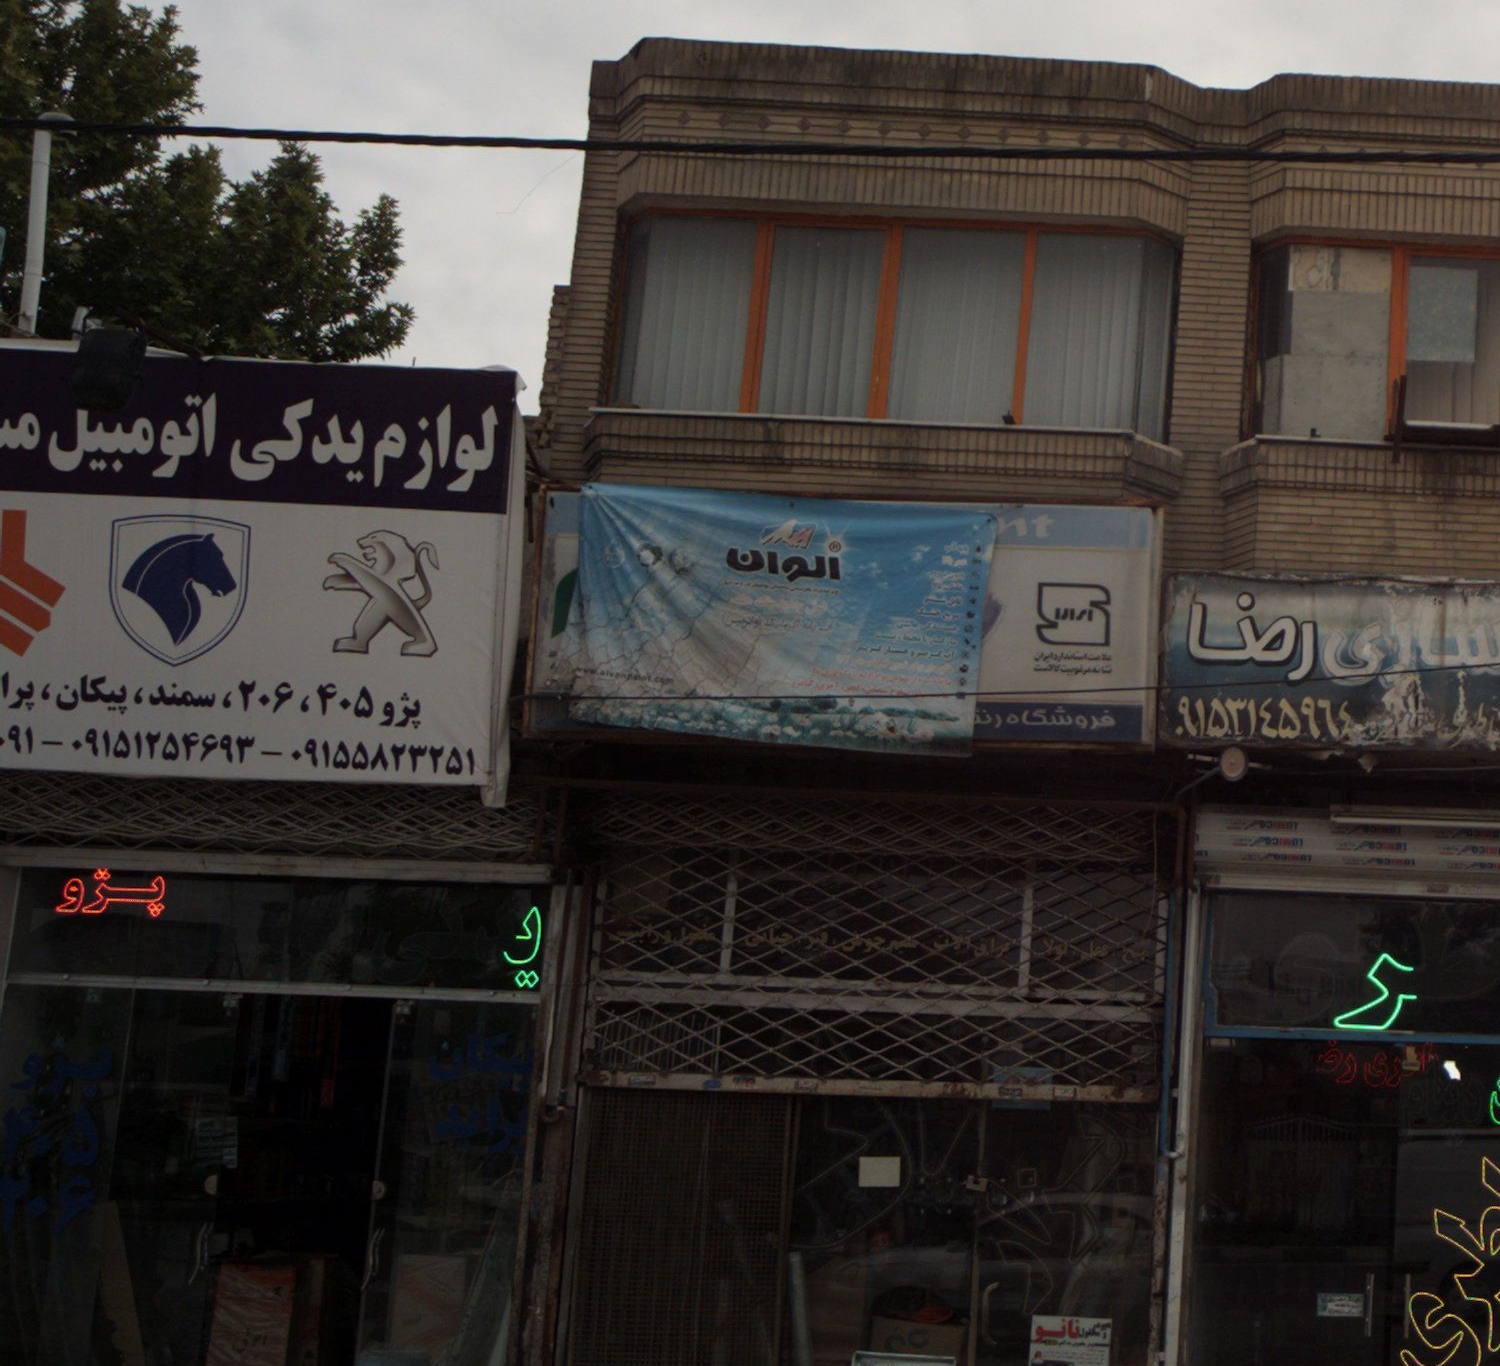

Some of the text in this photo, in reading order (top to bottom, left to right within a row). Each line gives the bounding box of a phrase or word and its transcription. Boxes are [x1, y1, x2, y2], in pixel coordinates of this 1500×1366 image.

[48, 393, 218, 478] اتومبیل
[230, 398, 364, 482] یدکی
[374, 404, 499, 492] لوازم
[725, 546, 842, 583] الوان
[1186, 590, 1319, 683] رضا
[55, 867, 167, 920] پژو
